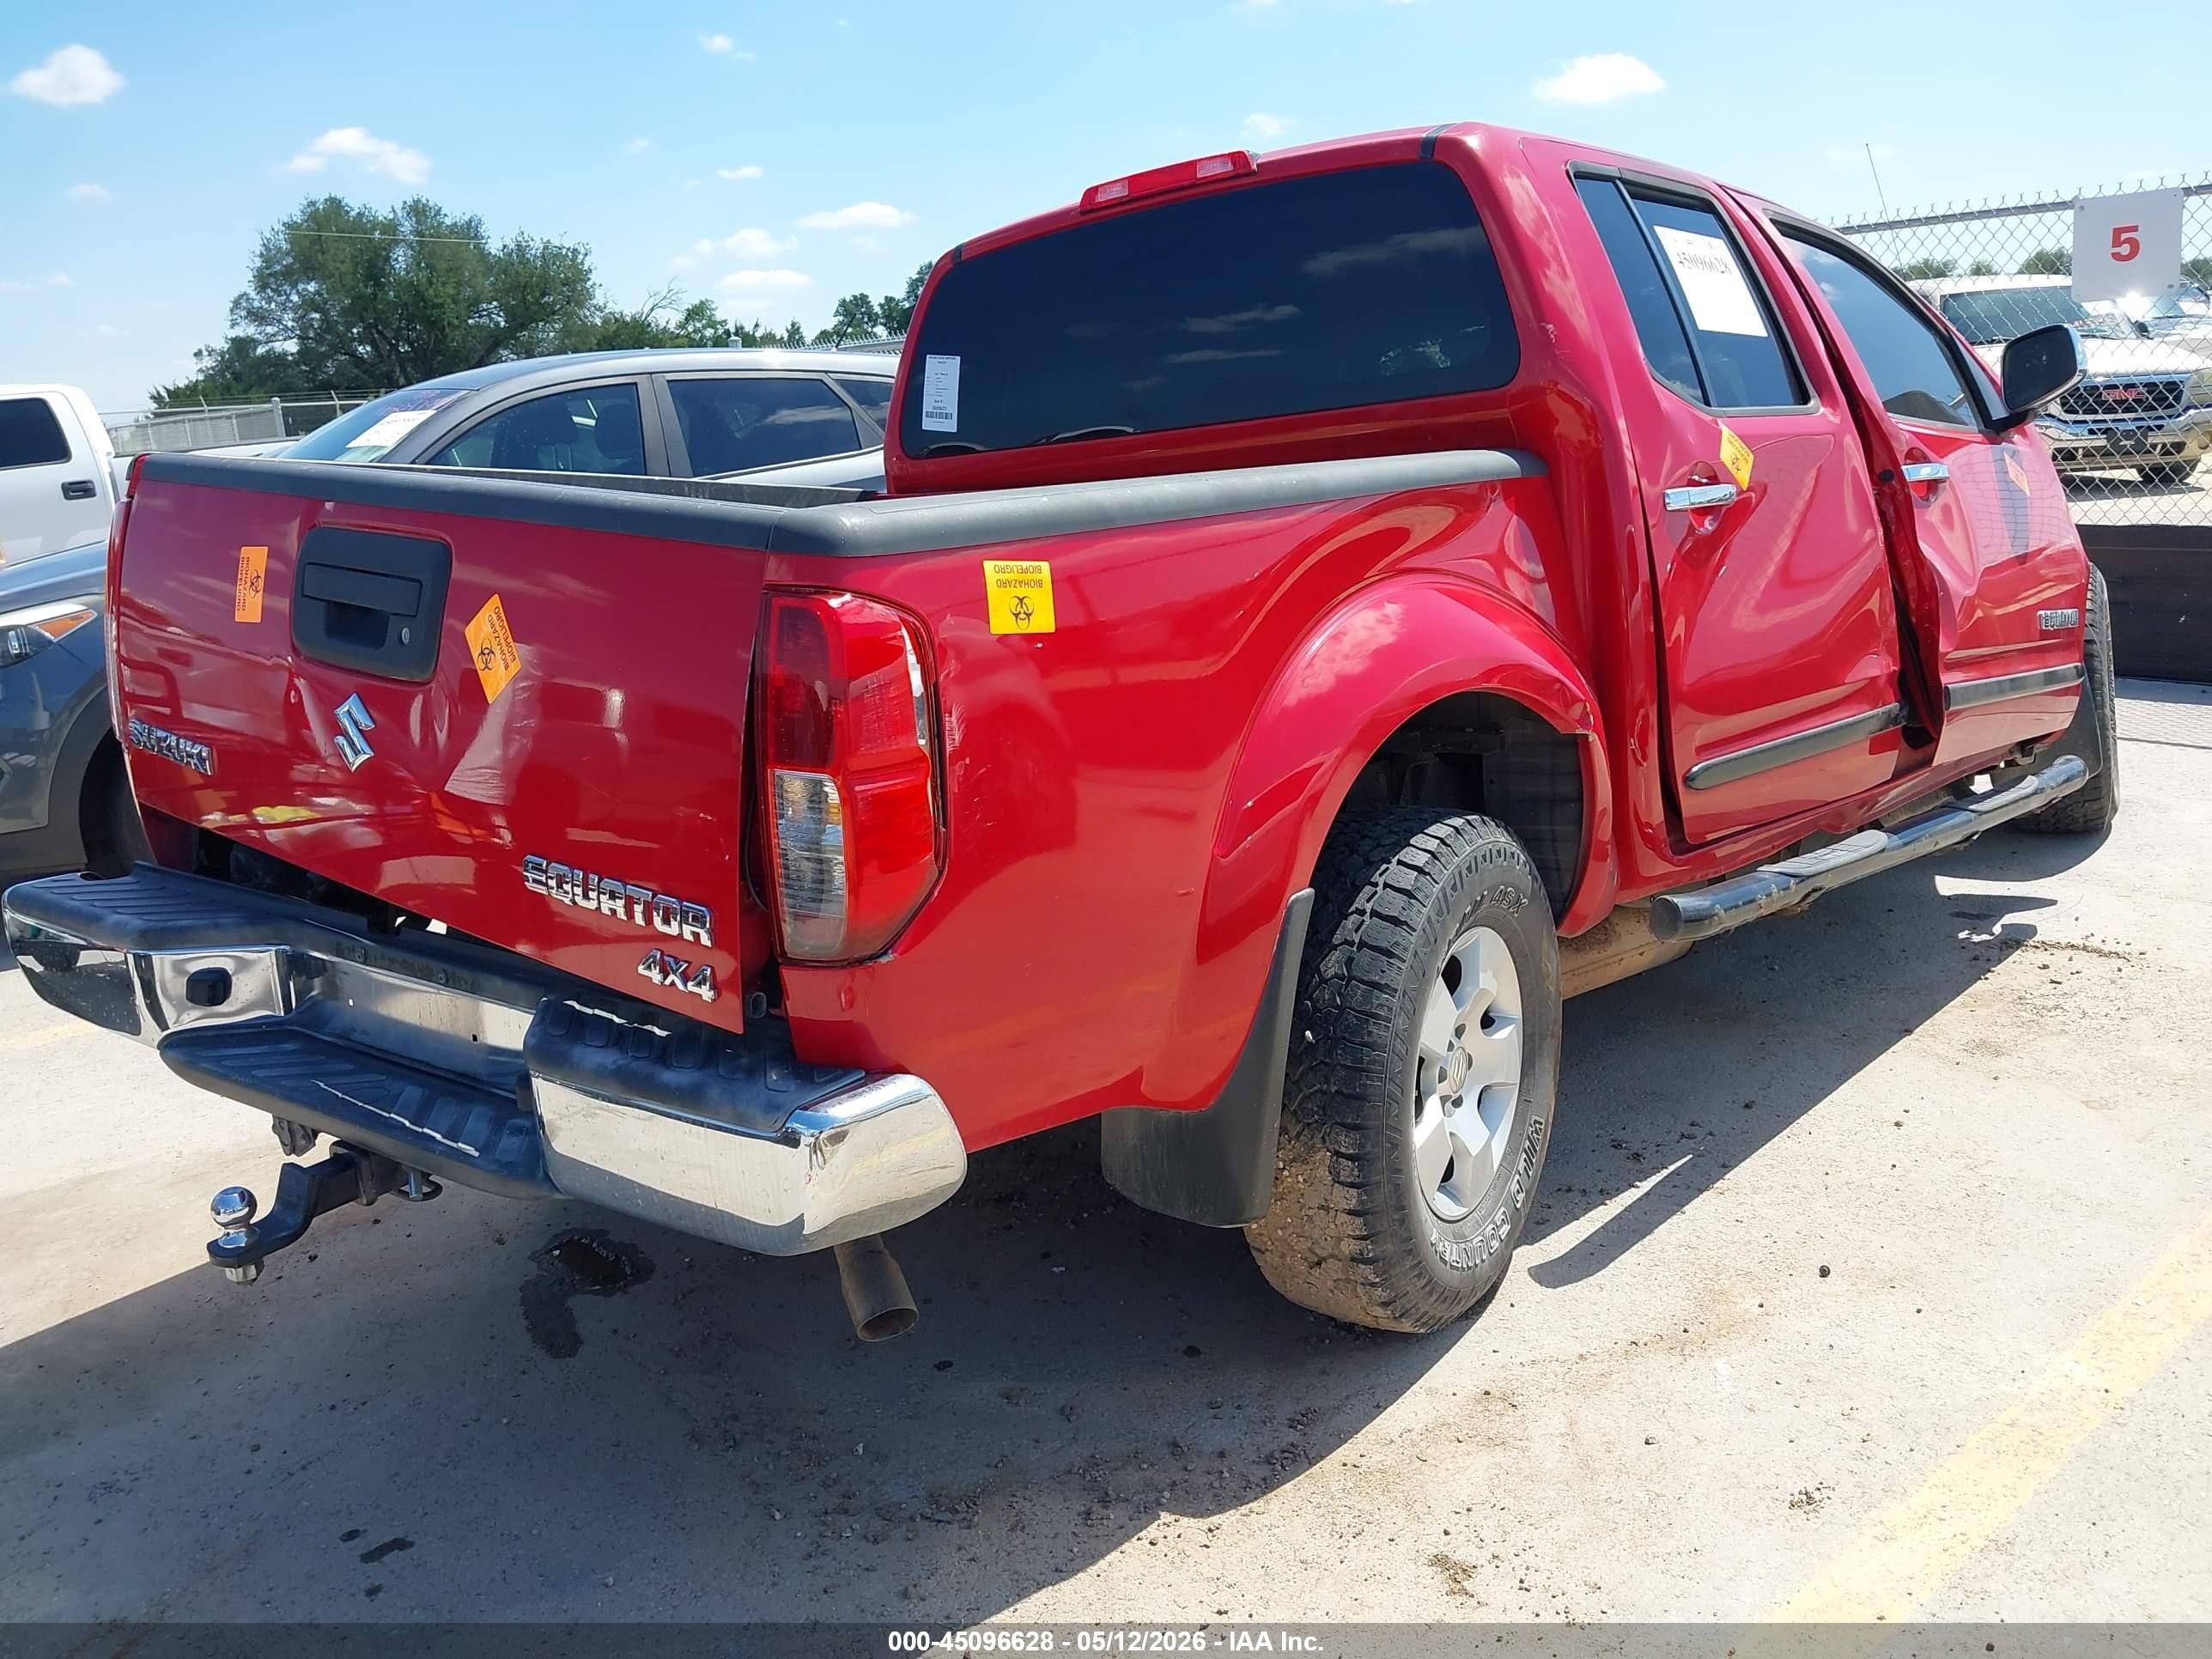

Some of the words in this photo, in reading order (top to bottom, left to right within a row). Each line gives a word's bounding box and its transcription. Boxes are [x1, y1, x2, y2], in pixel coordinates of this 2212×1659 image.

[2110, 224, 2140, 262] 5
[2101, 388, 2148, 401] GMC
[241, 556, 250, 611] BIOHAZARD
[994, 564, 1042, 574] BIOPELIGRO
[995, 579, 1043, 588] BIOHAZARD
[487, 614, 510, 672] BIOHAZARD
[494, 605, 517, 663] BIOPELIGRO
[128, 717, 213, 776] SUZUKI
[522, 854, 714, 948] EQUATOR
[1510, 1115, 1544, 1210] WILD
[1429, 1207, 1511, 1272] COUNTRY
